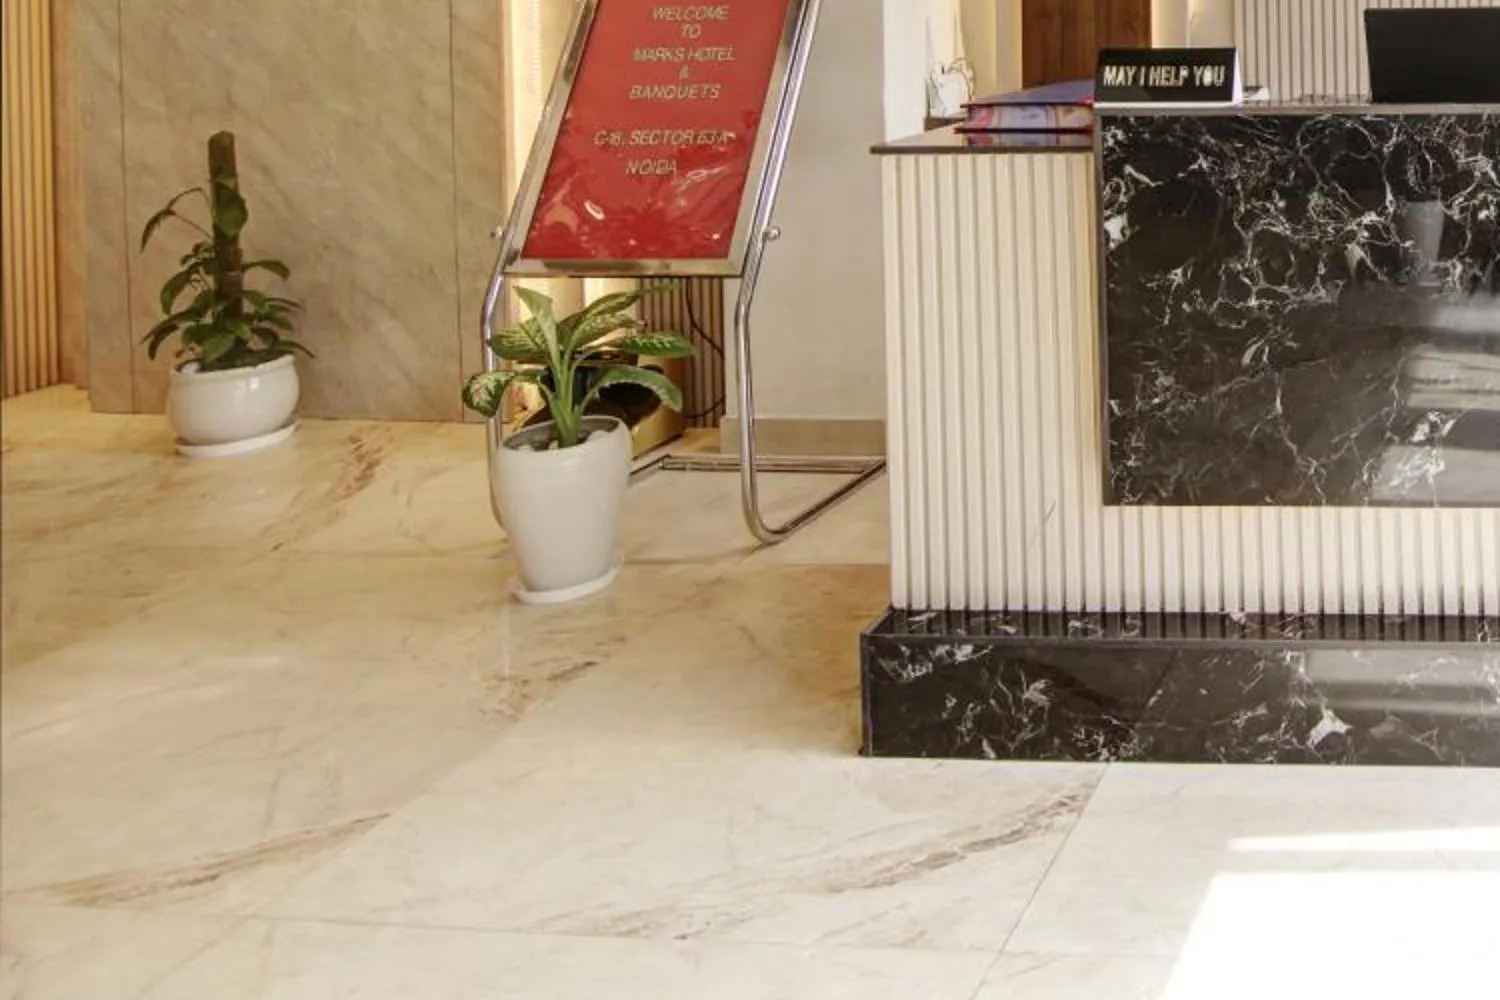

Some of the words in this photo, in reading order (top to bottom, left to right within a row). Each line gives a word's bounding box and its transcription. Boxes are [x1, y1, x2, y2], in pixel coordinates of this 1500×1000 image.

[653, 5, 730, 21] WELCOME
[681, 23, 702, 39] TO
[633, 47, 685, 62] MARKS
[687, 45, 736, 62] HOTEL
[1103, 65, 1137, 87] MAY
[1139, 65, 1146, 87] I
[1147, 65, 1190, 87] HELP
[1193, 65, 1226, 87] YOU
[629, 83, 721, 100] BANQUETS
[629, 128, 694, 146] SECTOR
[625, 159, 678, 176] NOIDA
